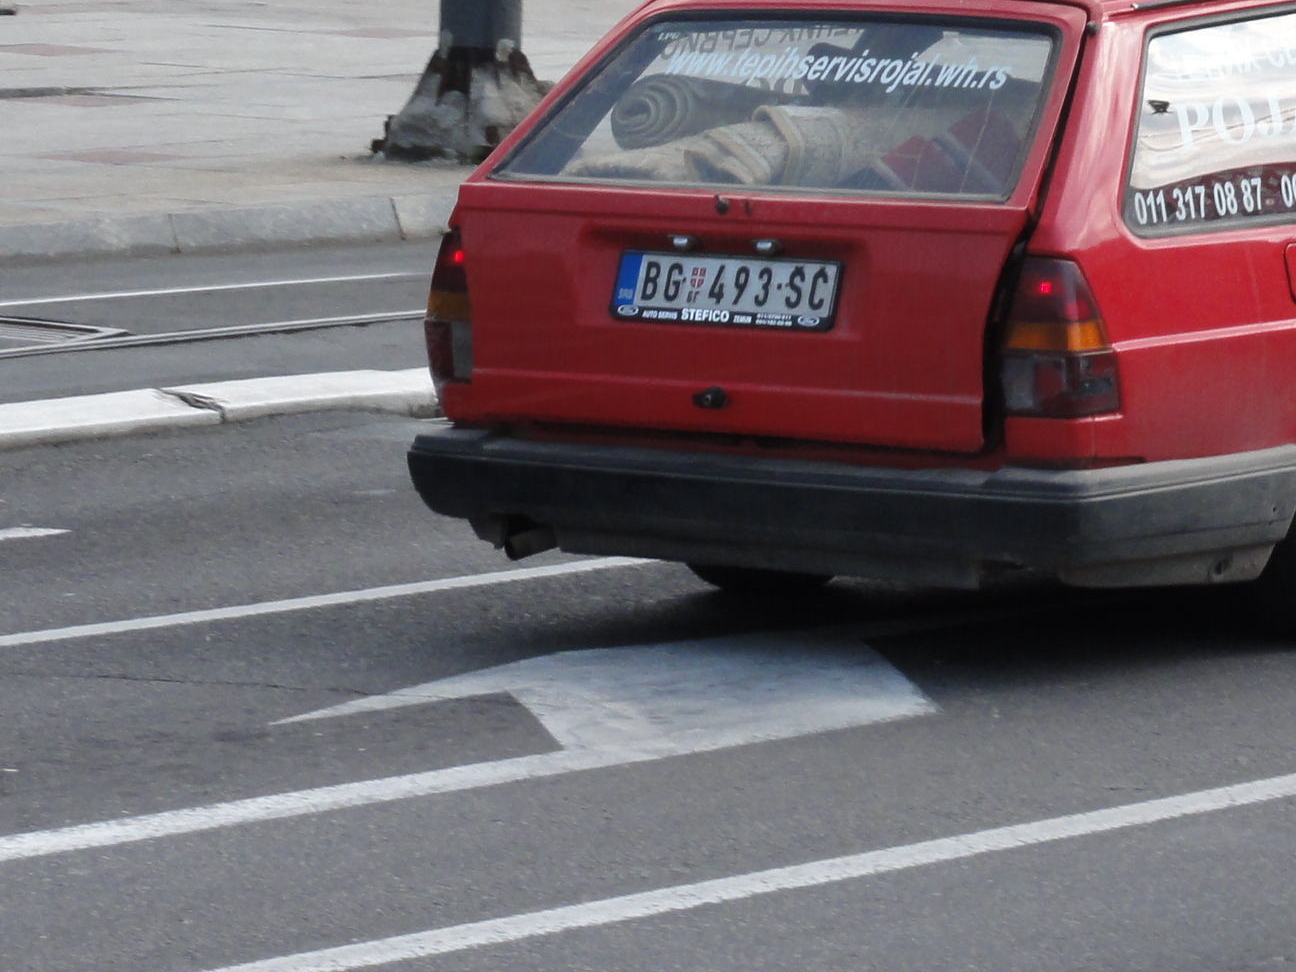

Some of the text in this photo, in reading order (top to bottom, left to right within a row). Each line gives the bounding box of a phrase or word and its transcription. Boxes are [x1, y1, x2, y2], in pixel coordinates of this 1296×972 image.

[1134, 191, 1167, 225] 011
[1173, 185, 1206, 221] 317
[1213, 181, 1238, 216] 08
[1241, 178, 1262, 212] 87
[681, 308, 730, 323] STEFICO
